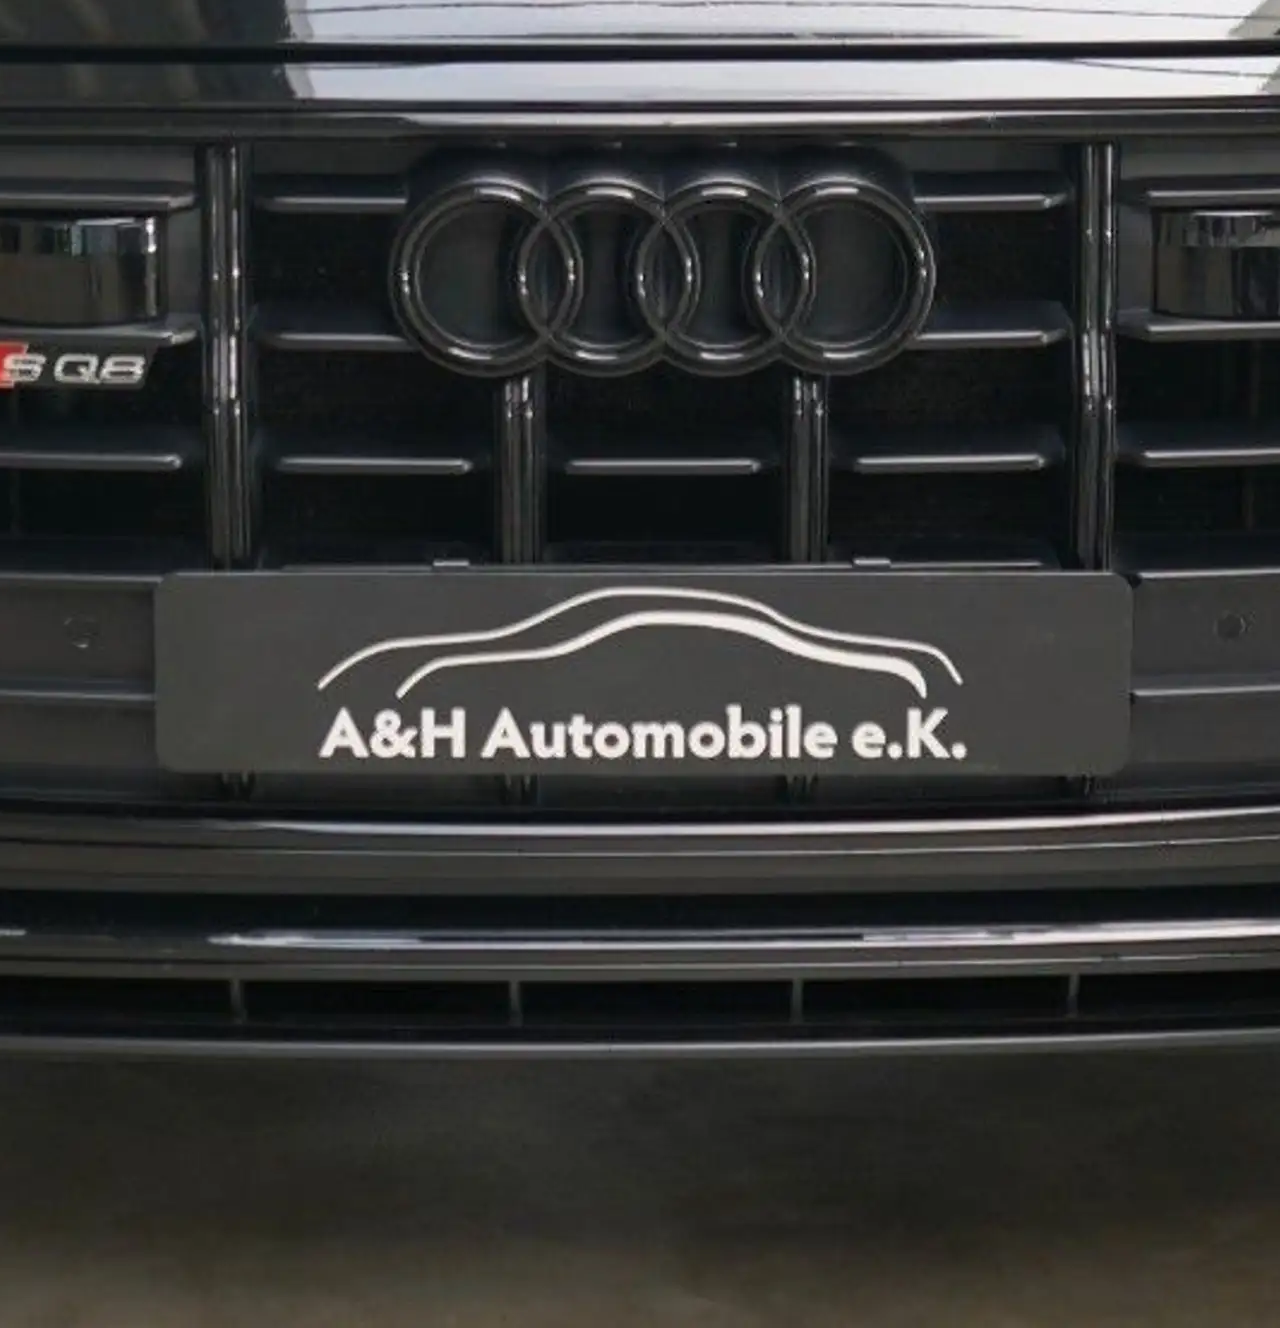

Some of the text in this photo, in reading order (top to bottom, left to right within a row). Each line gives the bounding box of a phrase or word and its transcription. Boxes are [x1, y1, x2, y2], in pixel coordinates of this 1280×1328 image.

[318, 703, 968, 760] A&H Automobile e.K.
